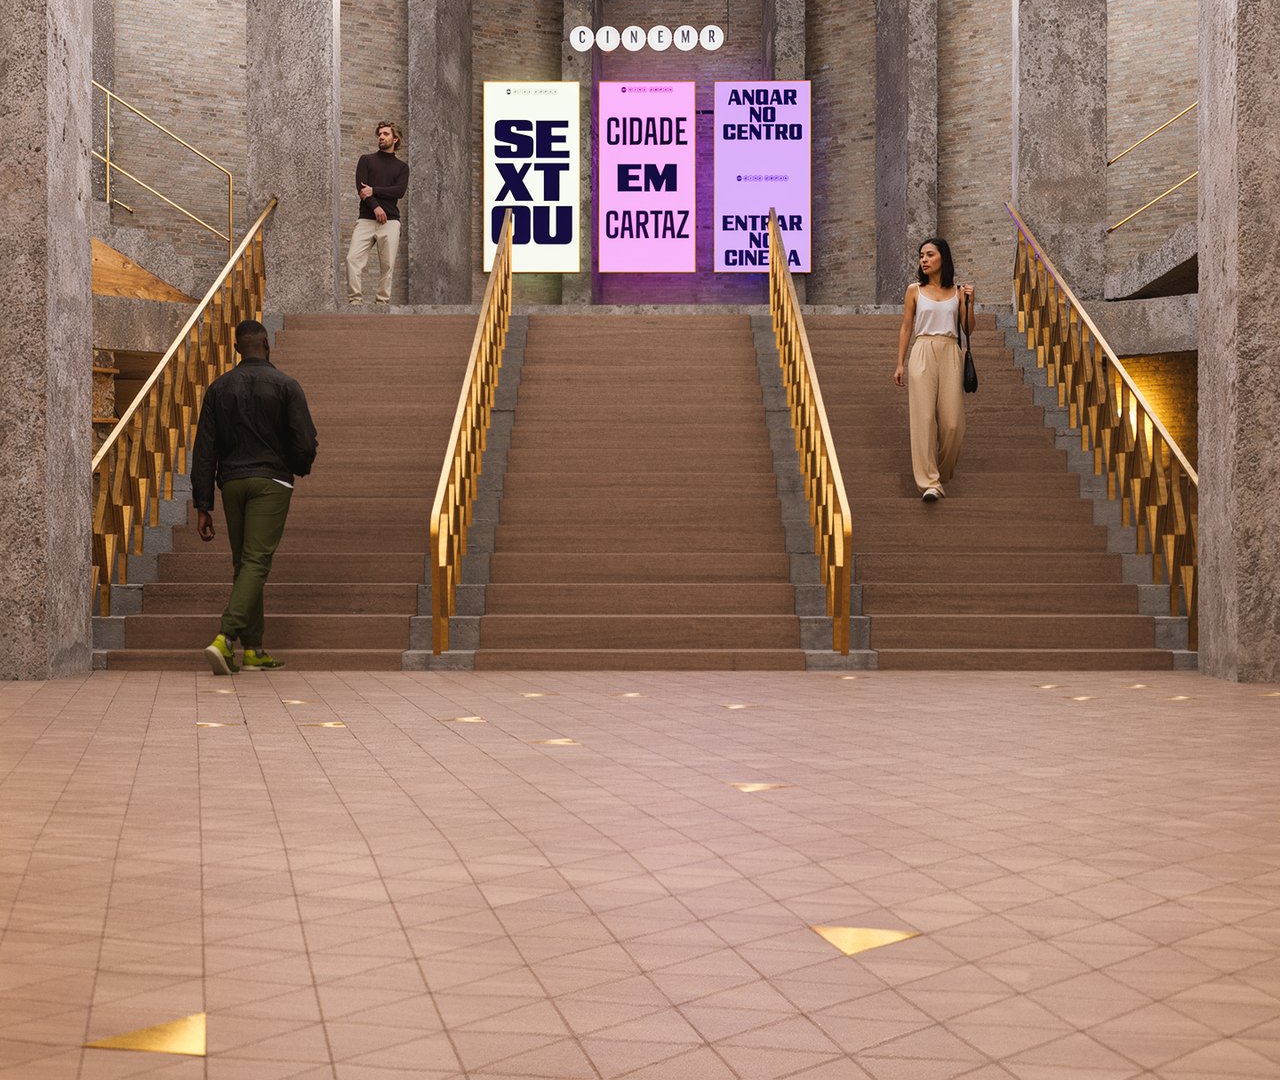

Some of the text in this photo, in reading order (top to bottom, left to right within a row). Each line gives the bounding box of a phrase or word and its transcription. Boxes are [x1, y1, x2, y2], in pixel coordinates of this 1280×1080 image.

[749, 106, 776, 123] NO
[494, 119, 570, 159] SE
[606, 116, 689, 146] CIDADE
[723, 123, 802, 140] CENTRO
[494, 162, 570, 202] XT
[617, 163, 678, 193] EM
[491, 205, 573, 245] OU
[605, 210, 690, 239] CARTAZ
[724, 249, 801, 266] CINEA
